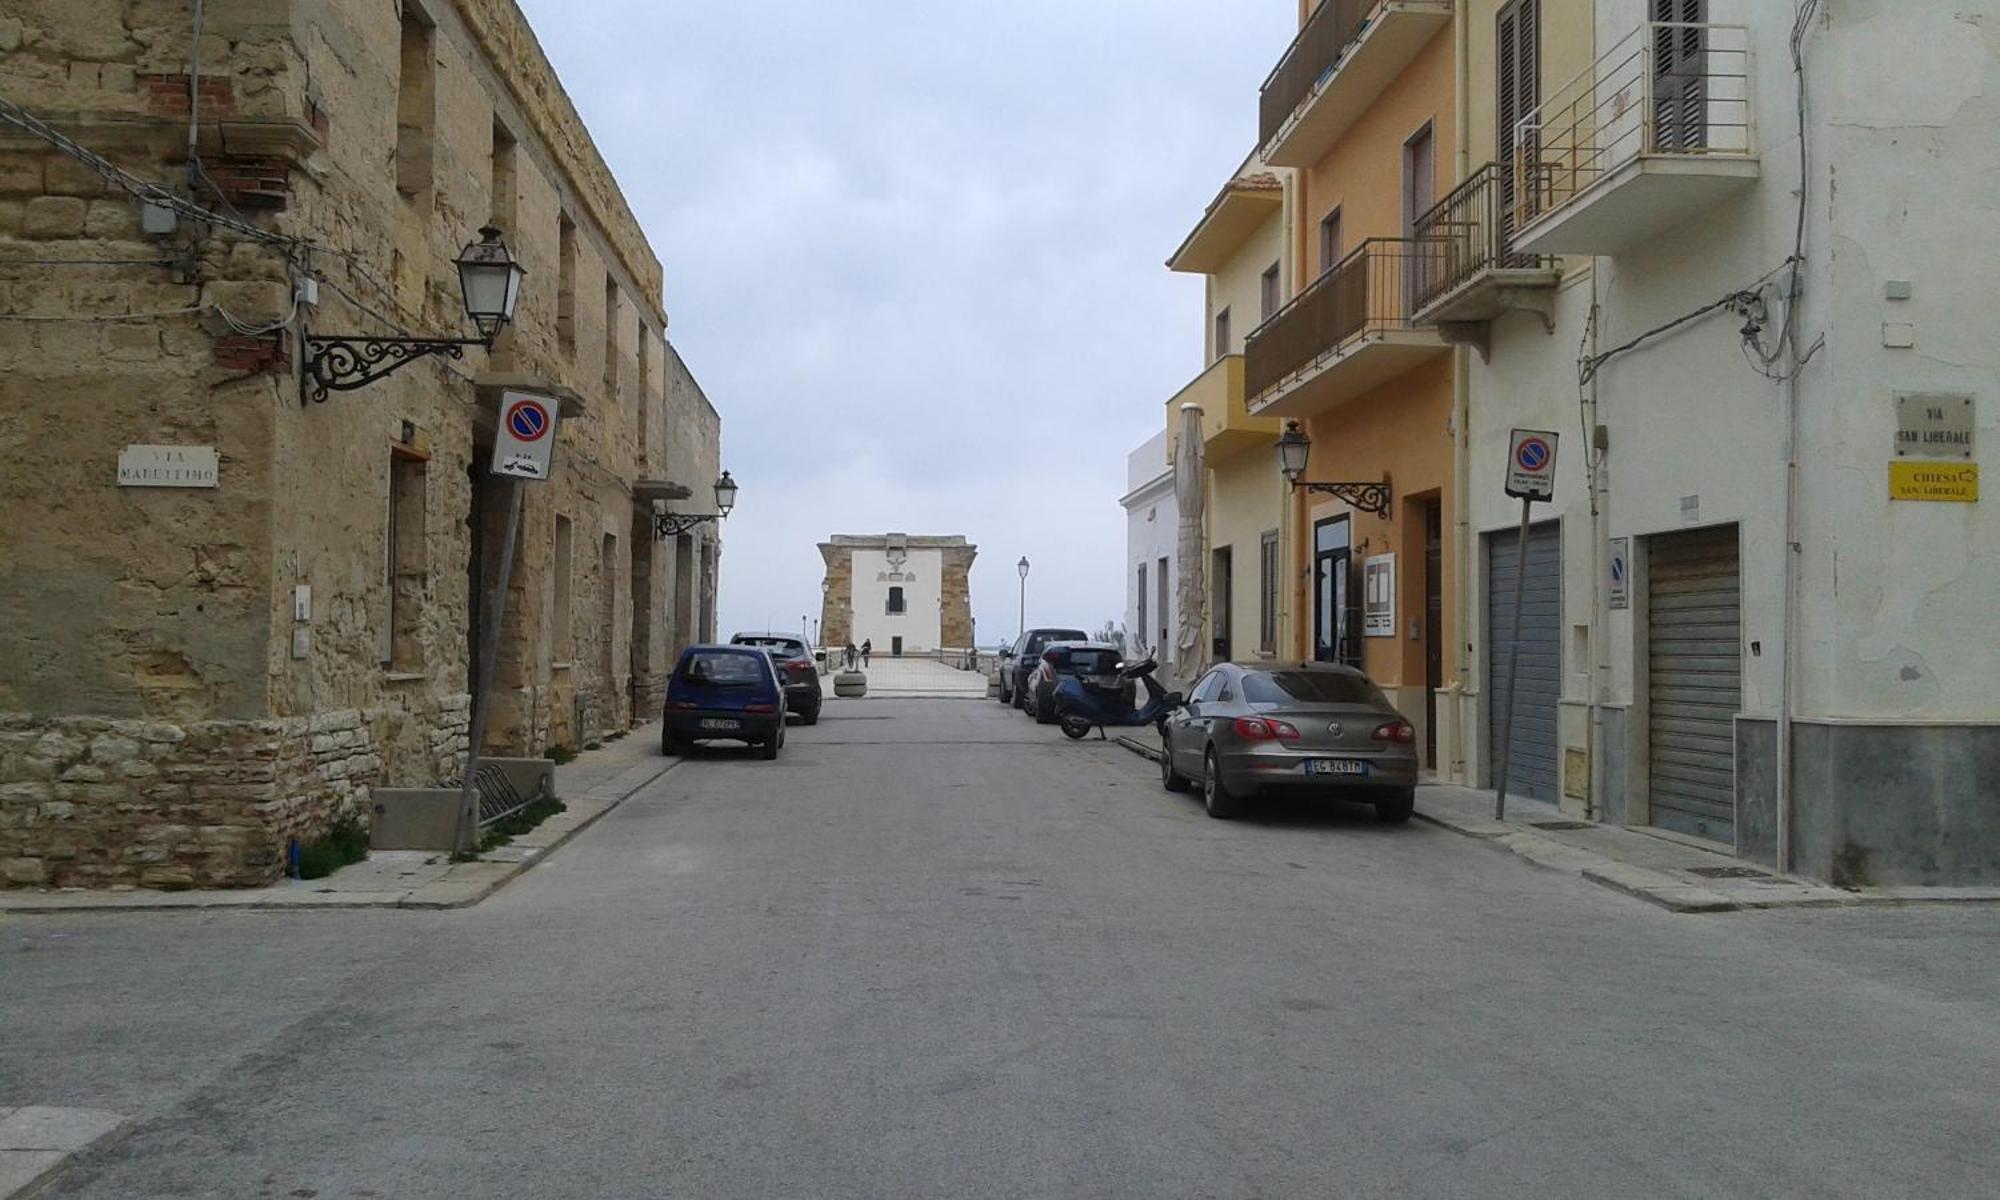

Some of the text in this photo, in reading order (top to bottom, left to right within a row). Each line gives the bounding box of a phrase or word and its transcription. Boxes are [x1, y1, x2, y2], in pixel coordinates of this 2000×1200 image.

[1926, 407, 1944, 420] VIA
[1897, 430, 1971, 445] SAN LIBERALE
[152, 450, 186, 463] VIA
[1913, 472, 1958, 483] CHIESA
[1900, 487, 1919, 495] SAN
